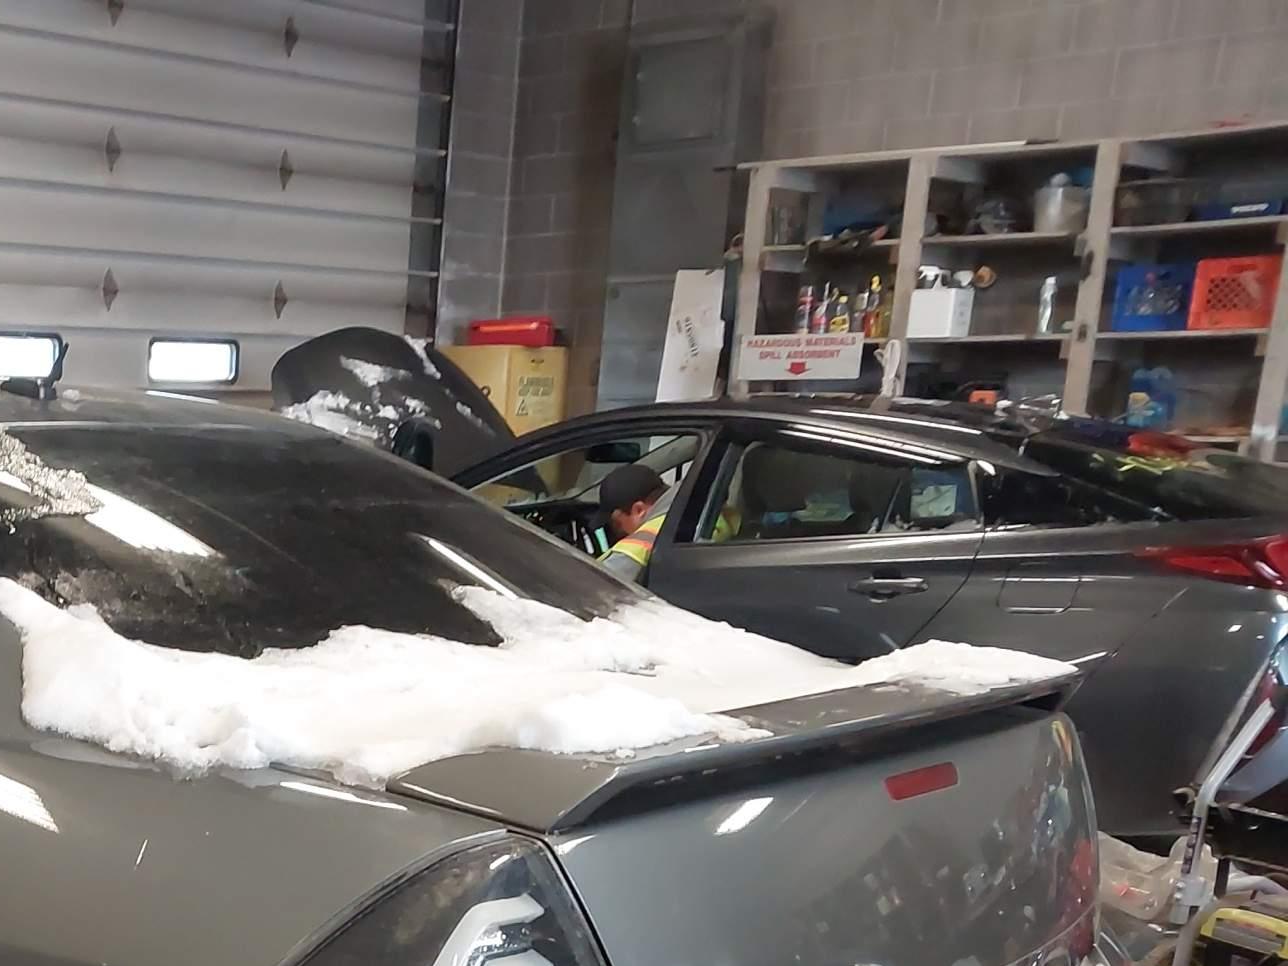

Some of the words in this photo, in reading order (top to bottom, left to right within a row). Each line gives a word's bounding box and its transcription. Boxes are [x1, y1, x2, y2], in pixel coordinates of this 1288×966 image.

[747, 338, 801, 349] HAZARDOUS
[805, 335, 857, 347] MATERIALS
[759, 350, 781, 360] SPILL
[786, 349, 841, 360] ABSORBENT
